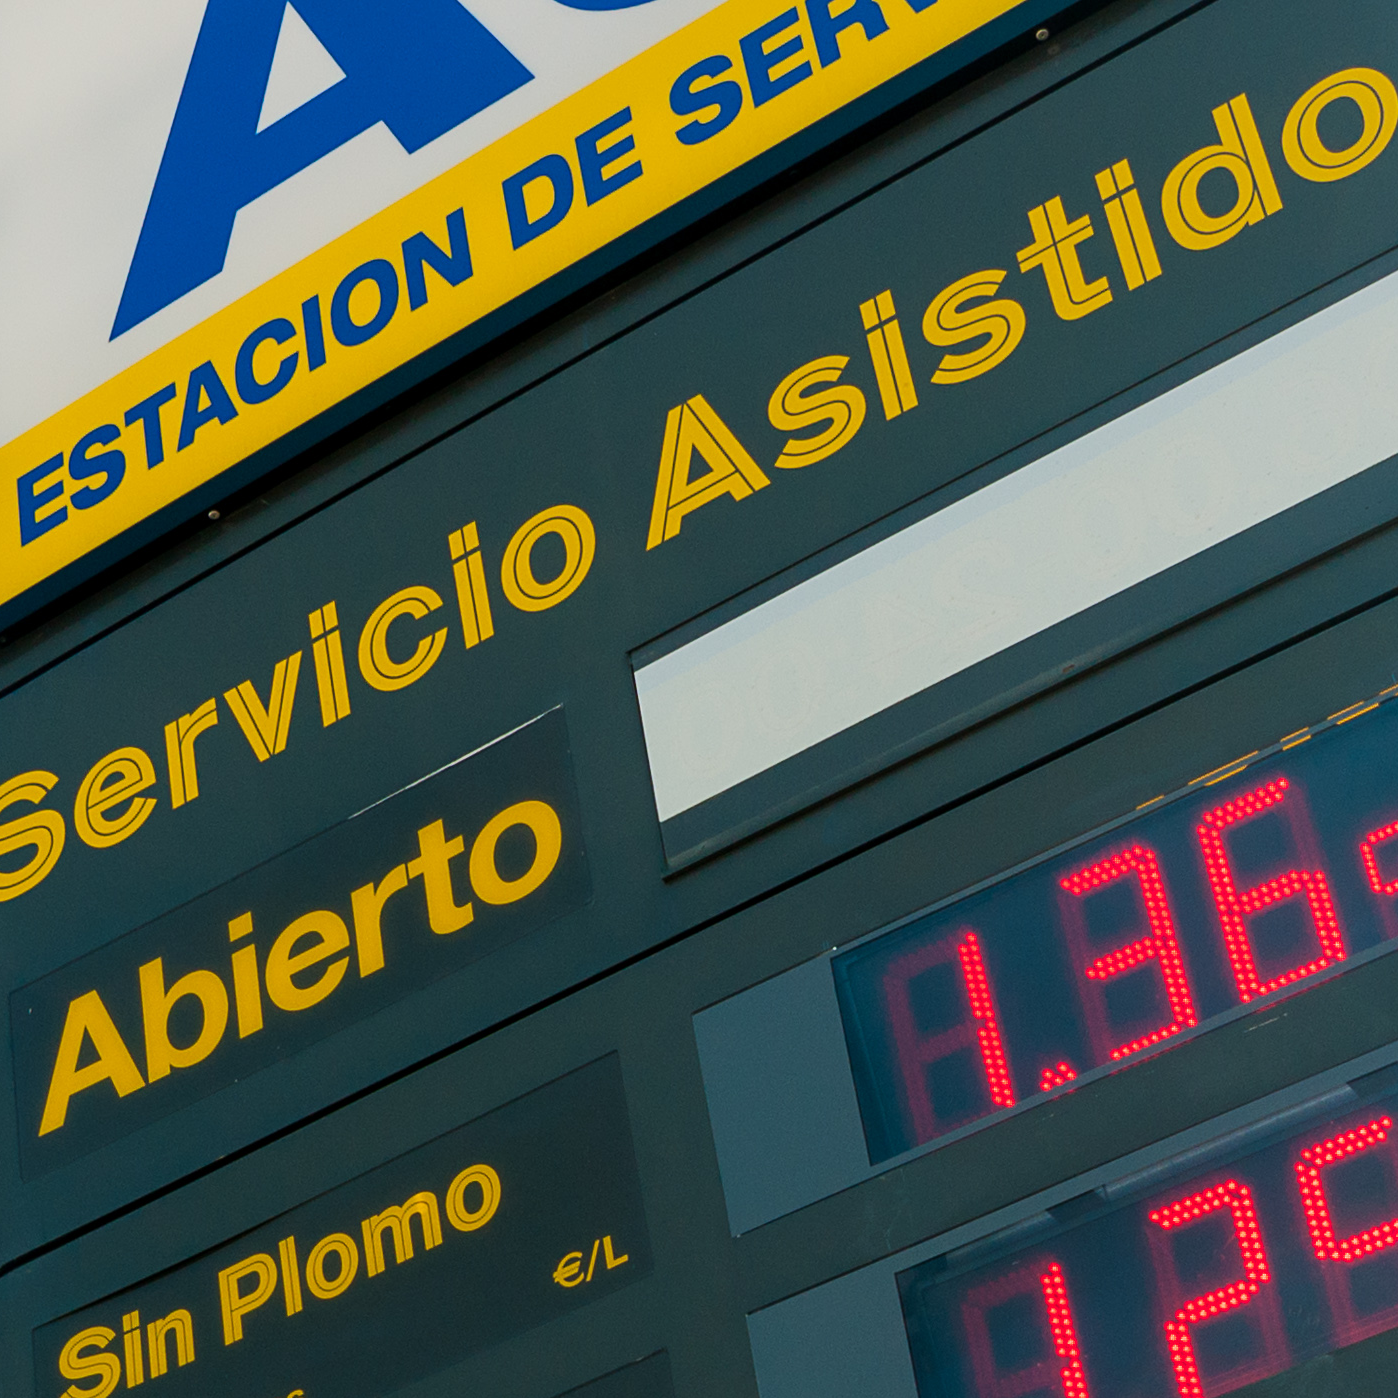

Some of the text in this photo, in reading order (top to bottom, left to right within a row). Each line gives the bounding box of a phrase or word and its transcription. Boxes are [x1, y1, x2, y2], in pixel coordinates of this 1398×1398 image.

[17, 0, 939, 547] ESTACION DE SER
[108, 0, 702, 342] A
[38, 799, 563, 1137] Abierto
[218, 1163, 502, 1346] Plomo
[552, 1235, 629, 1289] €/L
